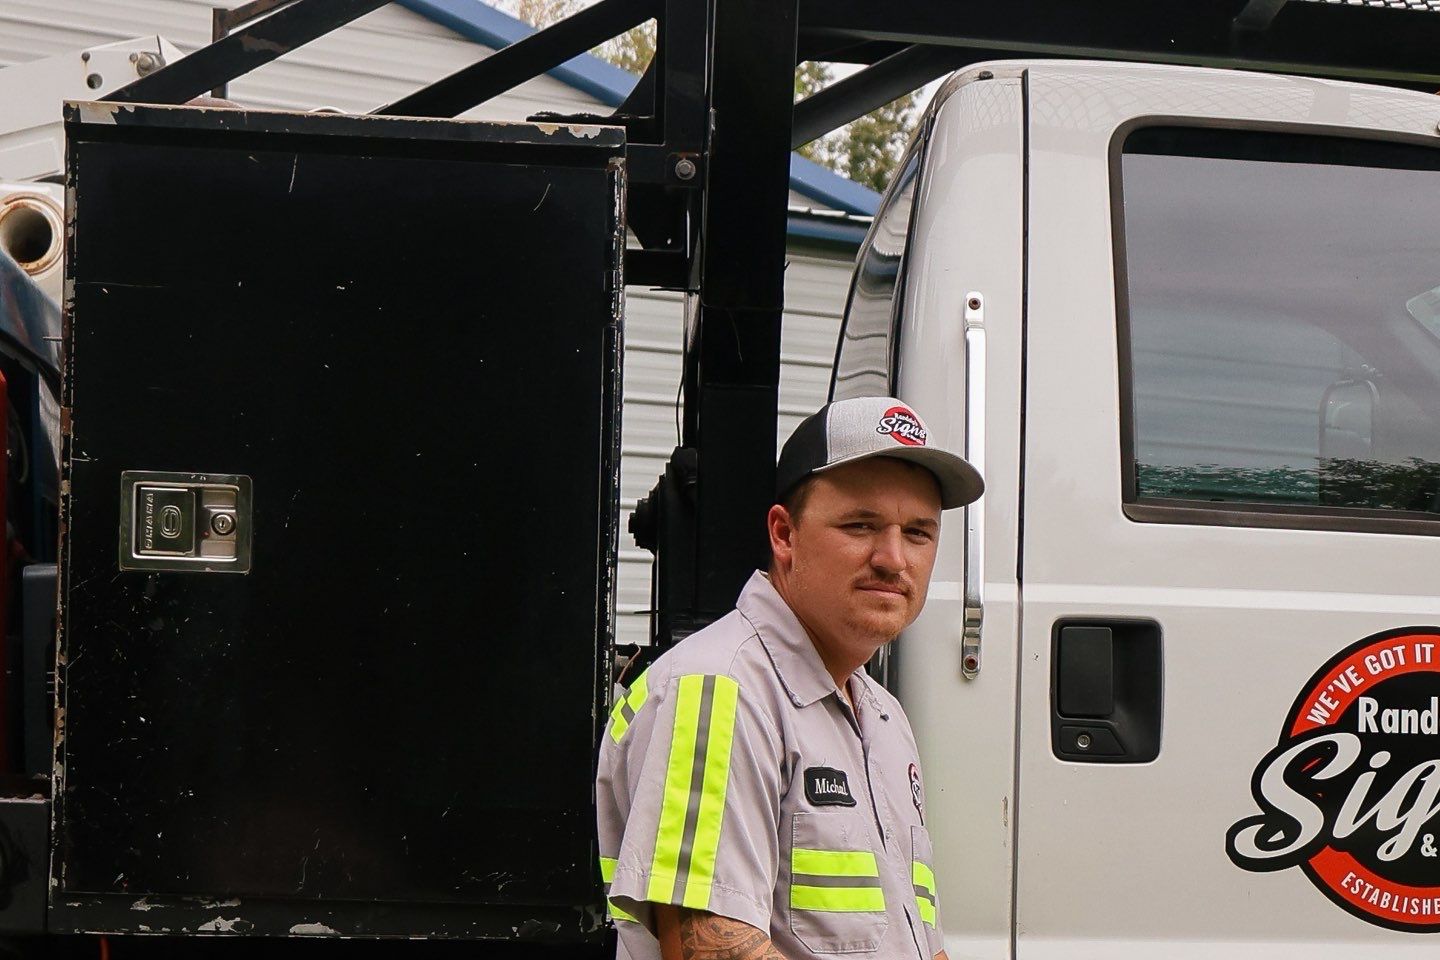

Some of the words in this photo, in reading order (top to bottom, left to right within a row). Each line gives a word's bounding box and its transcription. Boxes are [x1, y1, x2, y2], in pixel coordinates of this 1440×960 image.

[877, 417, 926, 439] Signs
[1307, 665, 1364, 726] WE'VE
[1365, 645, 1406, 676] GOT
[1415, 643, 1435, 664] IT
[1421, 834, 1437, 858] &
